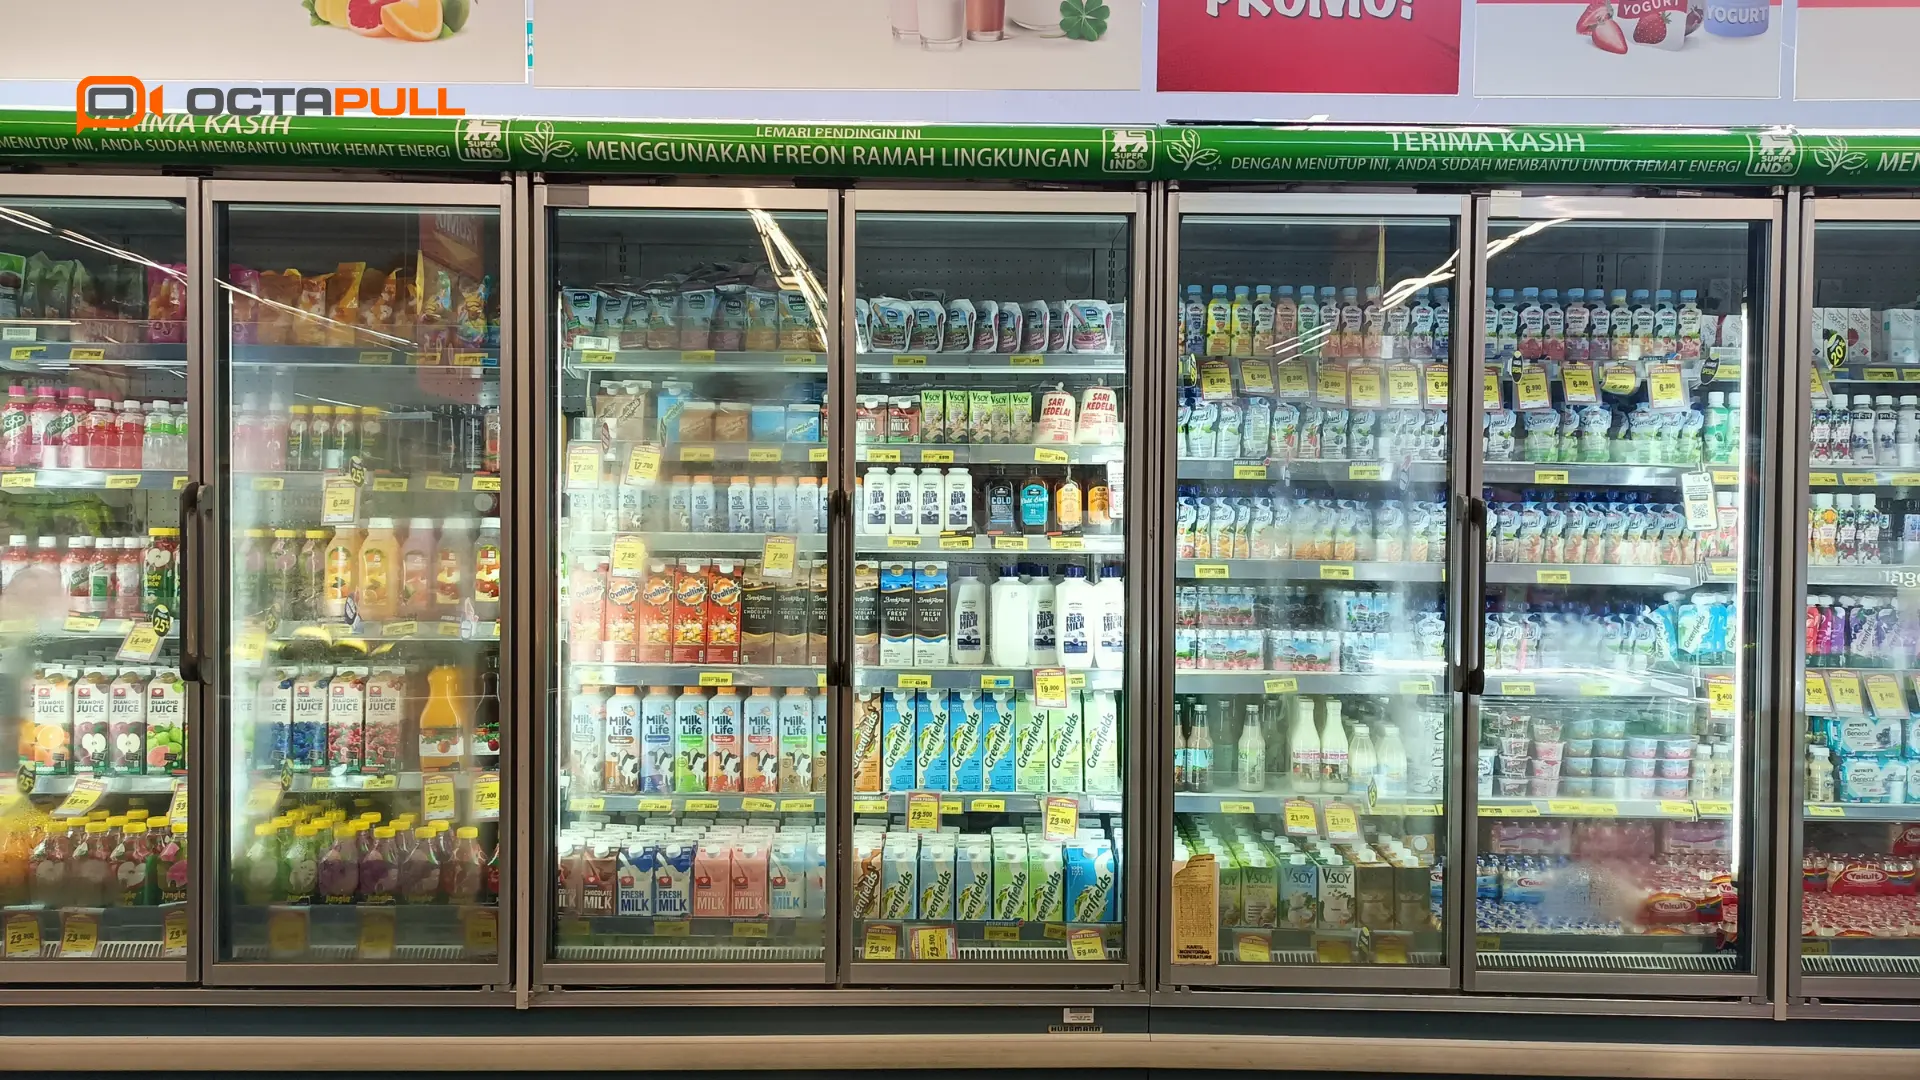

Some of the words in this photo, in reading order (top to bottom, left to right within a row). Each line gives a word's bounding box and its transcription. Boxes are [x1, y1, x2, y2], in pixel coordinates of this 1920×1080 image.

[1706, 5, 1767, 24] YOGURT
[204, 115, 291, 134] KASIH
[756, 127, 810, 138] LEMARI
[815, 127, 898, 138] PENDINGIN
[902, 129, 921, 139] INI
[1386, 132, 1494, 152] TERIMA
[1502, 133, 1585, 152] KASIH
[101, 139, 144, 151] ANDA
[147, 139, 198, 152] SUDAH
[201, 140, 287, 153] MEMBANTU
[290, 142, 341, 155] UNTUK
[344, 144, 395, 156] HEMAT
[400, 144, 450, 157] ENERGI
[464, 148, 503, 158] INDO
[586, 141, 766, 163] MENGGUNAKAN
[773, 145, 845, 165] FREON
[853, 146, 934, 166] RAMAH
[942, 148, 1089, 168] LINGKUNGAN
[1761, 155, 1791, 163] SUPER
[1110, 159, 1147, 170] INDO
[1231, 157, 1292, 169] DENGAN
[1295, 158, 1366, 170] MENUTUP
[1395, 158, 1437, 170] ANDA
[1440, 159, 1490, 170] SUDAH
[1494, 159, 1578, 171] MEMBANTU
[1583, 159, 1633, 171] UNTUK
[1637, 160, 1687, 172] HEMAT
[1689, 160, 1741, 173] ENERGI
[1754, 163, 1793, 173] INDO
[1048, 398, 1065, 406] SARI
[1092, 393, 1110, 402] SARI
[1042, 406, 1070, 416] KEDELAI
[1086, 402, 1116, 412] KEDELAI
[858, 422, 876, 431] MILK
[891, 422, 910, 432] MILK
[991, 496, 1011, 504] COLD
[610, 583, 636, 600] Ovaltine
[644, 585, 670, 600] Ovaltine
[678, 584, 704, 600] Ovaltine
[712, 584, 740, 600] Ovaltine
[960, 621, 977, 630] MILK
[1037, 621, 1054, 630] MILK
[1066, 622, 1084, 632] MILK
[1104, 622, 1122, 632] MILK
[38, 705, 64, 713] JUICE
[77, 705, 104, 713] JUICE
[112, 705, 139, 713] JUICE
[150, 705, 178, 713] JUICE
[296, 703, 323, 711] JUICE
[332, 703, 358, 711] JUICE
[368, 703, 396, 711] JUICE
[609, 716, 632, 726] Milk
[646, 715, 668, 726] Milk
[680, 714, 702, 726] Milk
[712, 716, 733, 726] Milk
[750, 716, 770, 726] Milk
[784, 716, 806, 726] Milk
[612, 725, 632, 736] Life
[650, 725, 670, 736] Life
[682, 725, 702, 735] Life
[715, 725, 734, 735] Life
[752, 726, 771, 736] Life
[787, 726, 806, 736] Life
[885, 711, 913, 768] Greenfields
[919, 711, 947, 768] Greenfields
[952, 711, 979, 768] Greenfields
[984, 711, 1012, 768] Greenfields
[1018, 712, 1045, 768] Greenfields
[1051, 712, 1079, 769] Greenfields
[1087, 712, 1114, 769] Greenfields
[1322, 868, 1352, 884] V-SOY
[162, 891, 185, 900] Jungle
[621, 890, 644, 898] FRESH
[584, 896, 612, 910] MILK
[621, 898, 649, 912] MILK
[659, 898, 687, 912] MILK
[697, 897, 725, 910] MILK
[734, 897, 762, 910] MILK
[773, 896, 800, 909] MILK
[1658, 902, 1688, 910] Yakult
